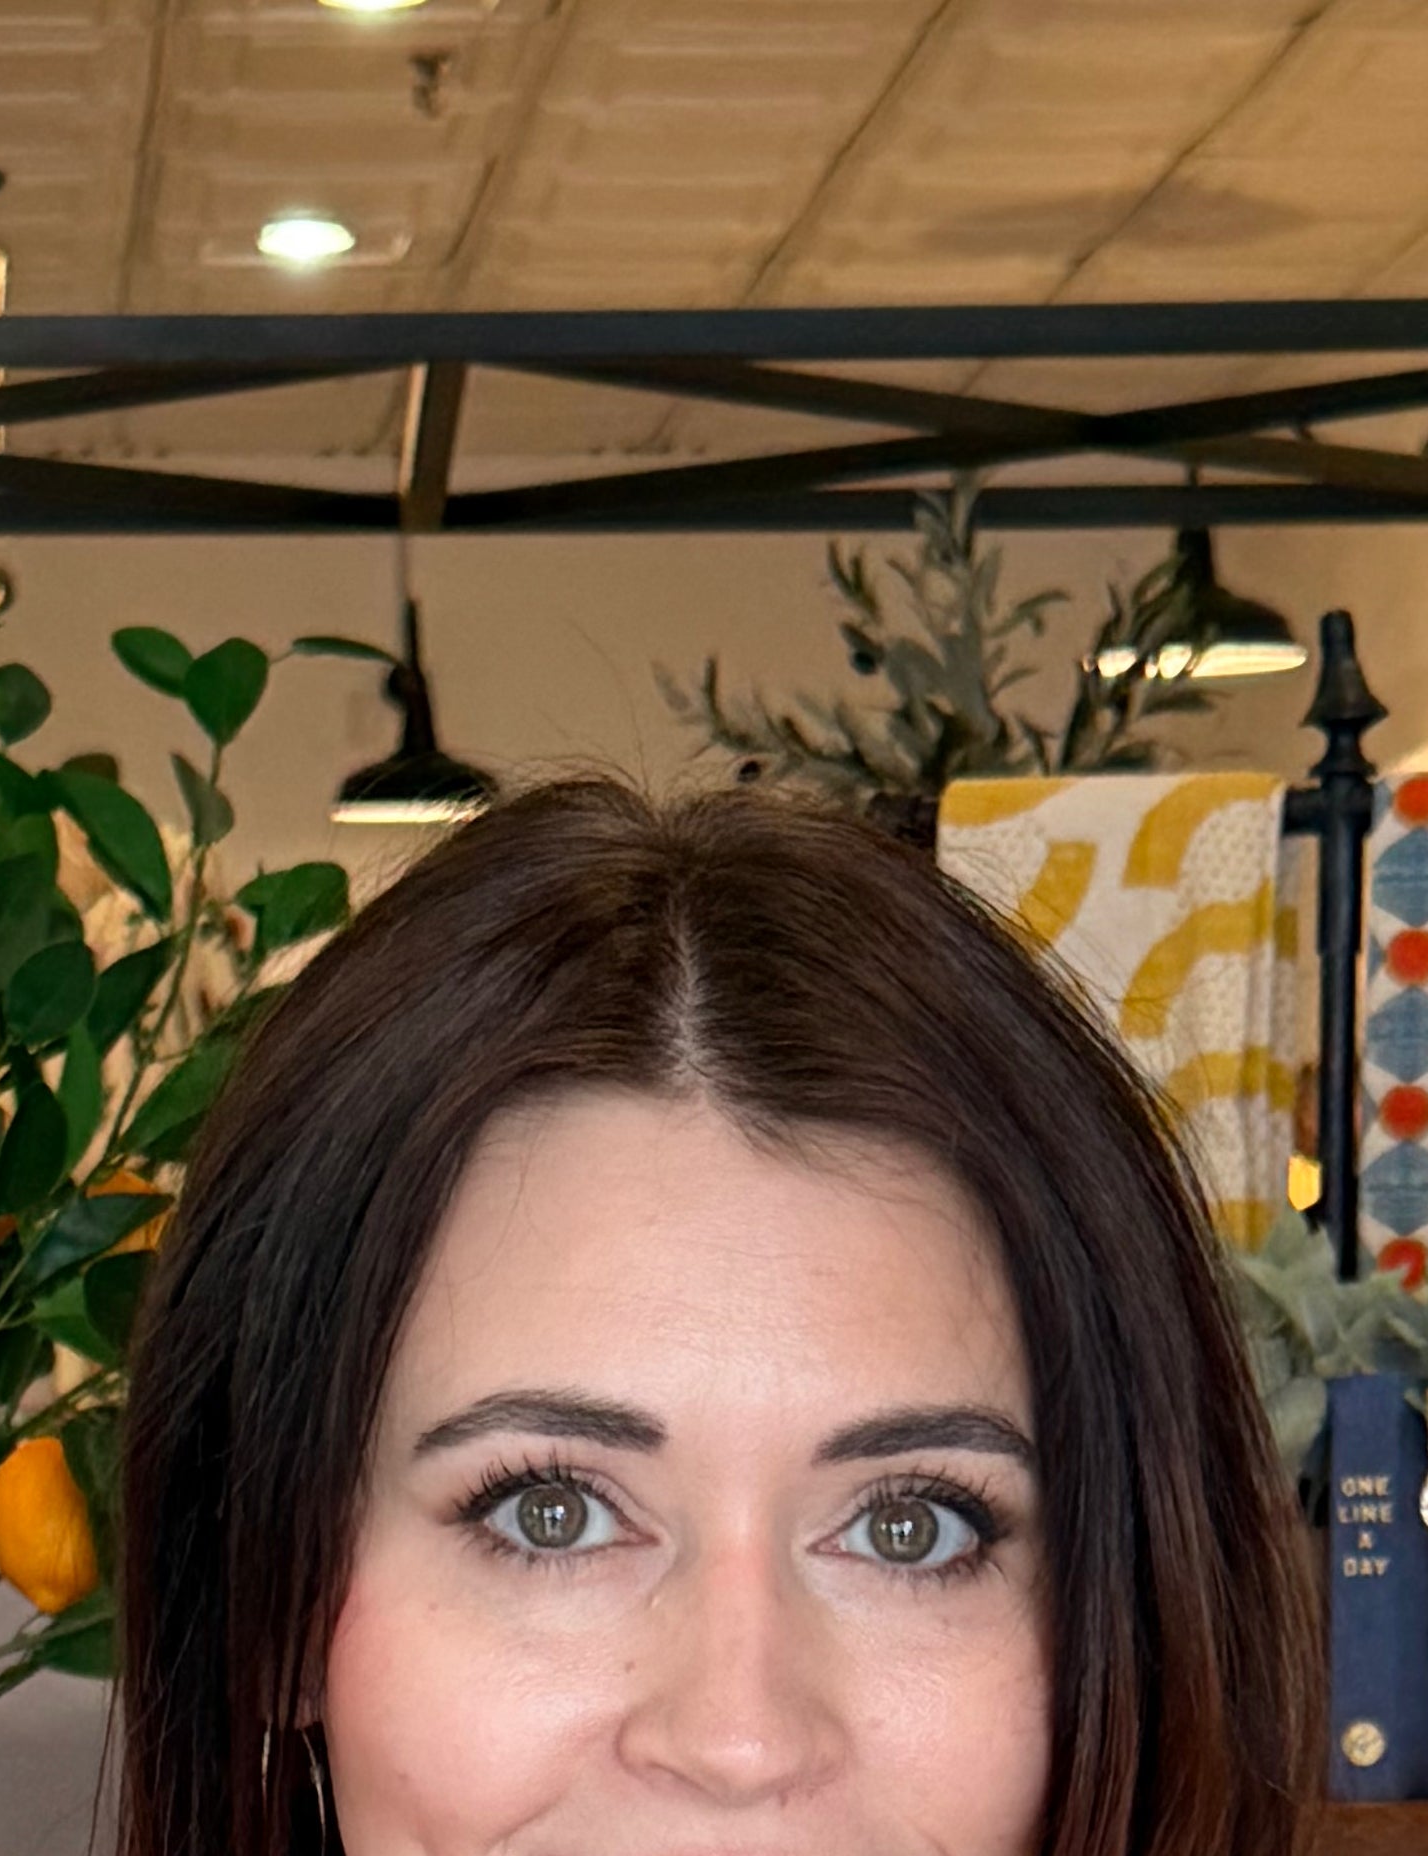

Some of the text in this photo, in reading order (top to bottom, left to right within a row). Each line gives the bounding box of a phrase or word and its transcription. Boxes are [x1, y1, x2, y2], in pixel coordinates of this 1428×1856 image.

[1340, 1475, 1390, 1498] ONE
[1338, 1503, 1393, 1524] LINE
[1357, 1532, 1373, 1550] A
[1343, 1557, 1390, 1578] DAY
